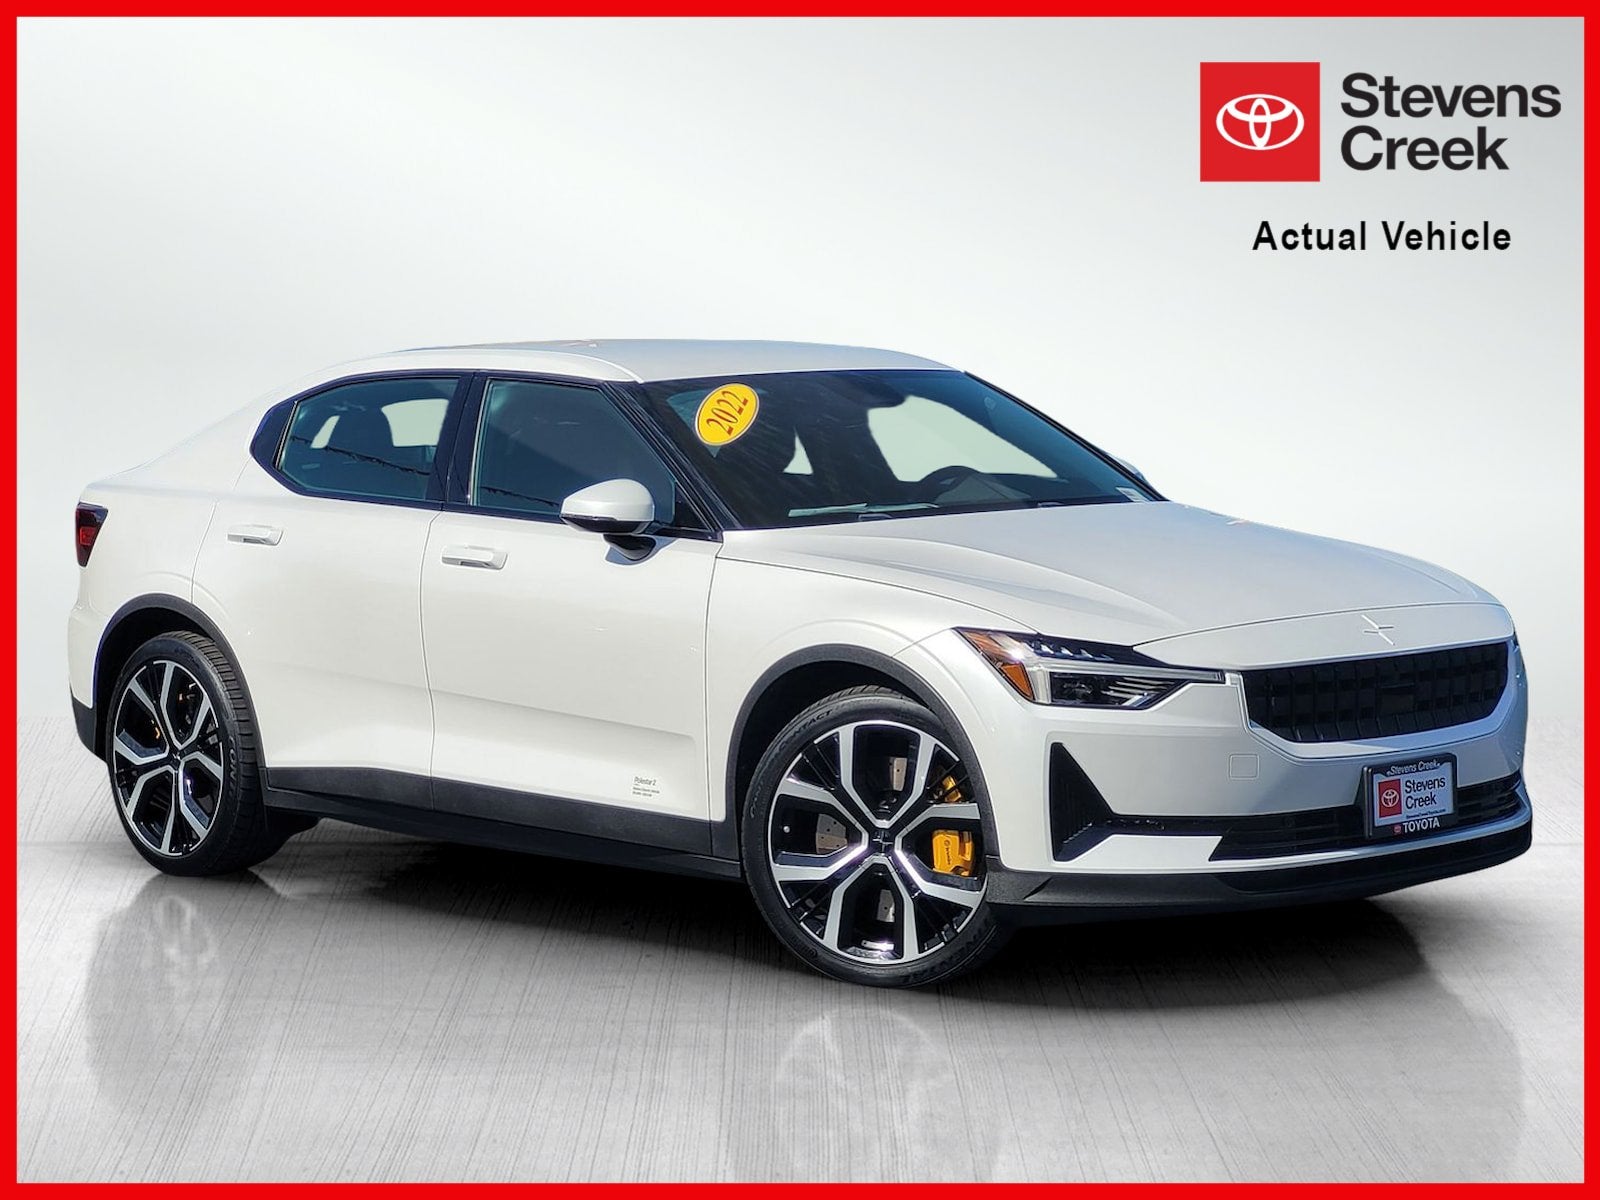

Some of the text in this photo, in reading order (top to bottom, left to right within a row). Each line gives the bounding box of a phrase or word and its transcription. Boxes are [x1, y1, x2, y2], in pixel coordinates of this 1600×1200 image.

[706, 390, 749, 436] 2022
[1405, 777, 1446, 794] Stevens
[1405, 791, 1437, 809] Creek
[1402, 816, 1441, 833] TOYOTA
